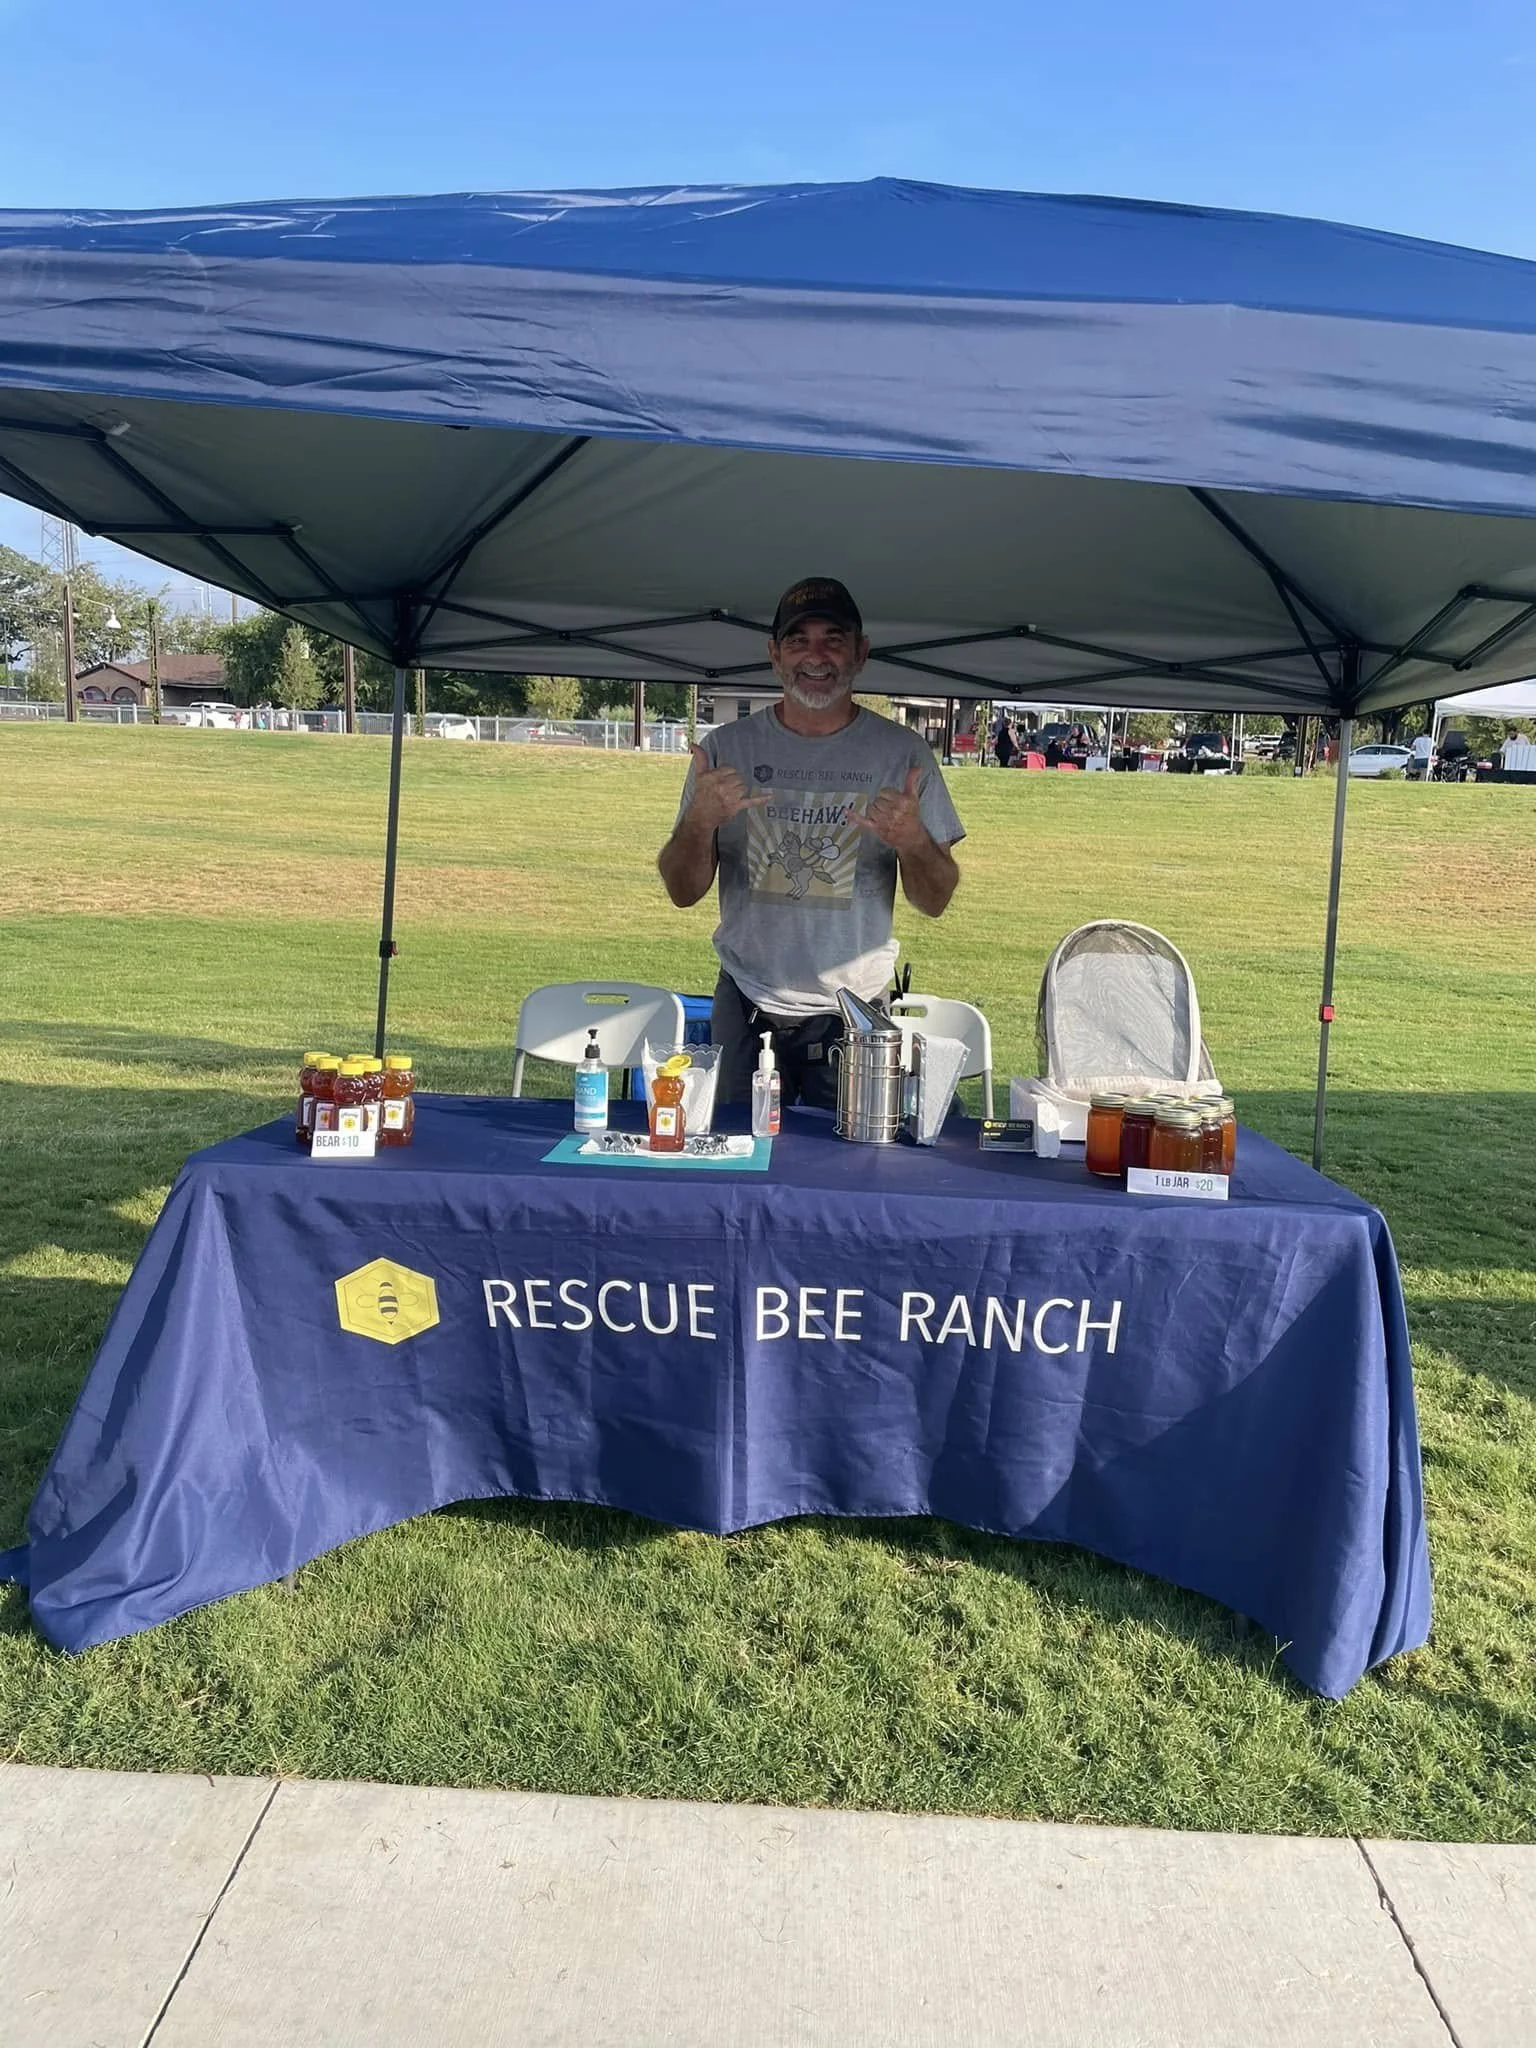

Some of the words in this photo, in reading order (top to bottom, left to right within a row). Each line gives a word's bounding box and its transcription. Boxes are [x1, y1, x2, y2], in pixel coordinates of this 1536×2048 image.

[777, 768, 814, 781] RESCUE
[841, 771, 873, 784] RANCH
[766, 801, 854, 826] BEEHAW!
[316, 1135, 340, 1147] BEAR
[1172, 1176, 1190, 1189] JAR
[1195, 1179, 1213, 1191] $20
[482, 1278, 717, 1340] RESCUE
[755, 1286, 864, 1341] BEE
[900, 1291, 1122, 1354] RANCH
